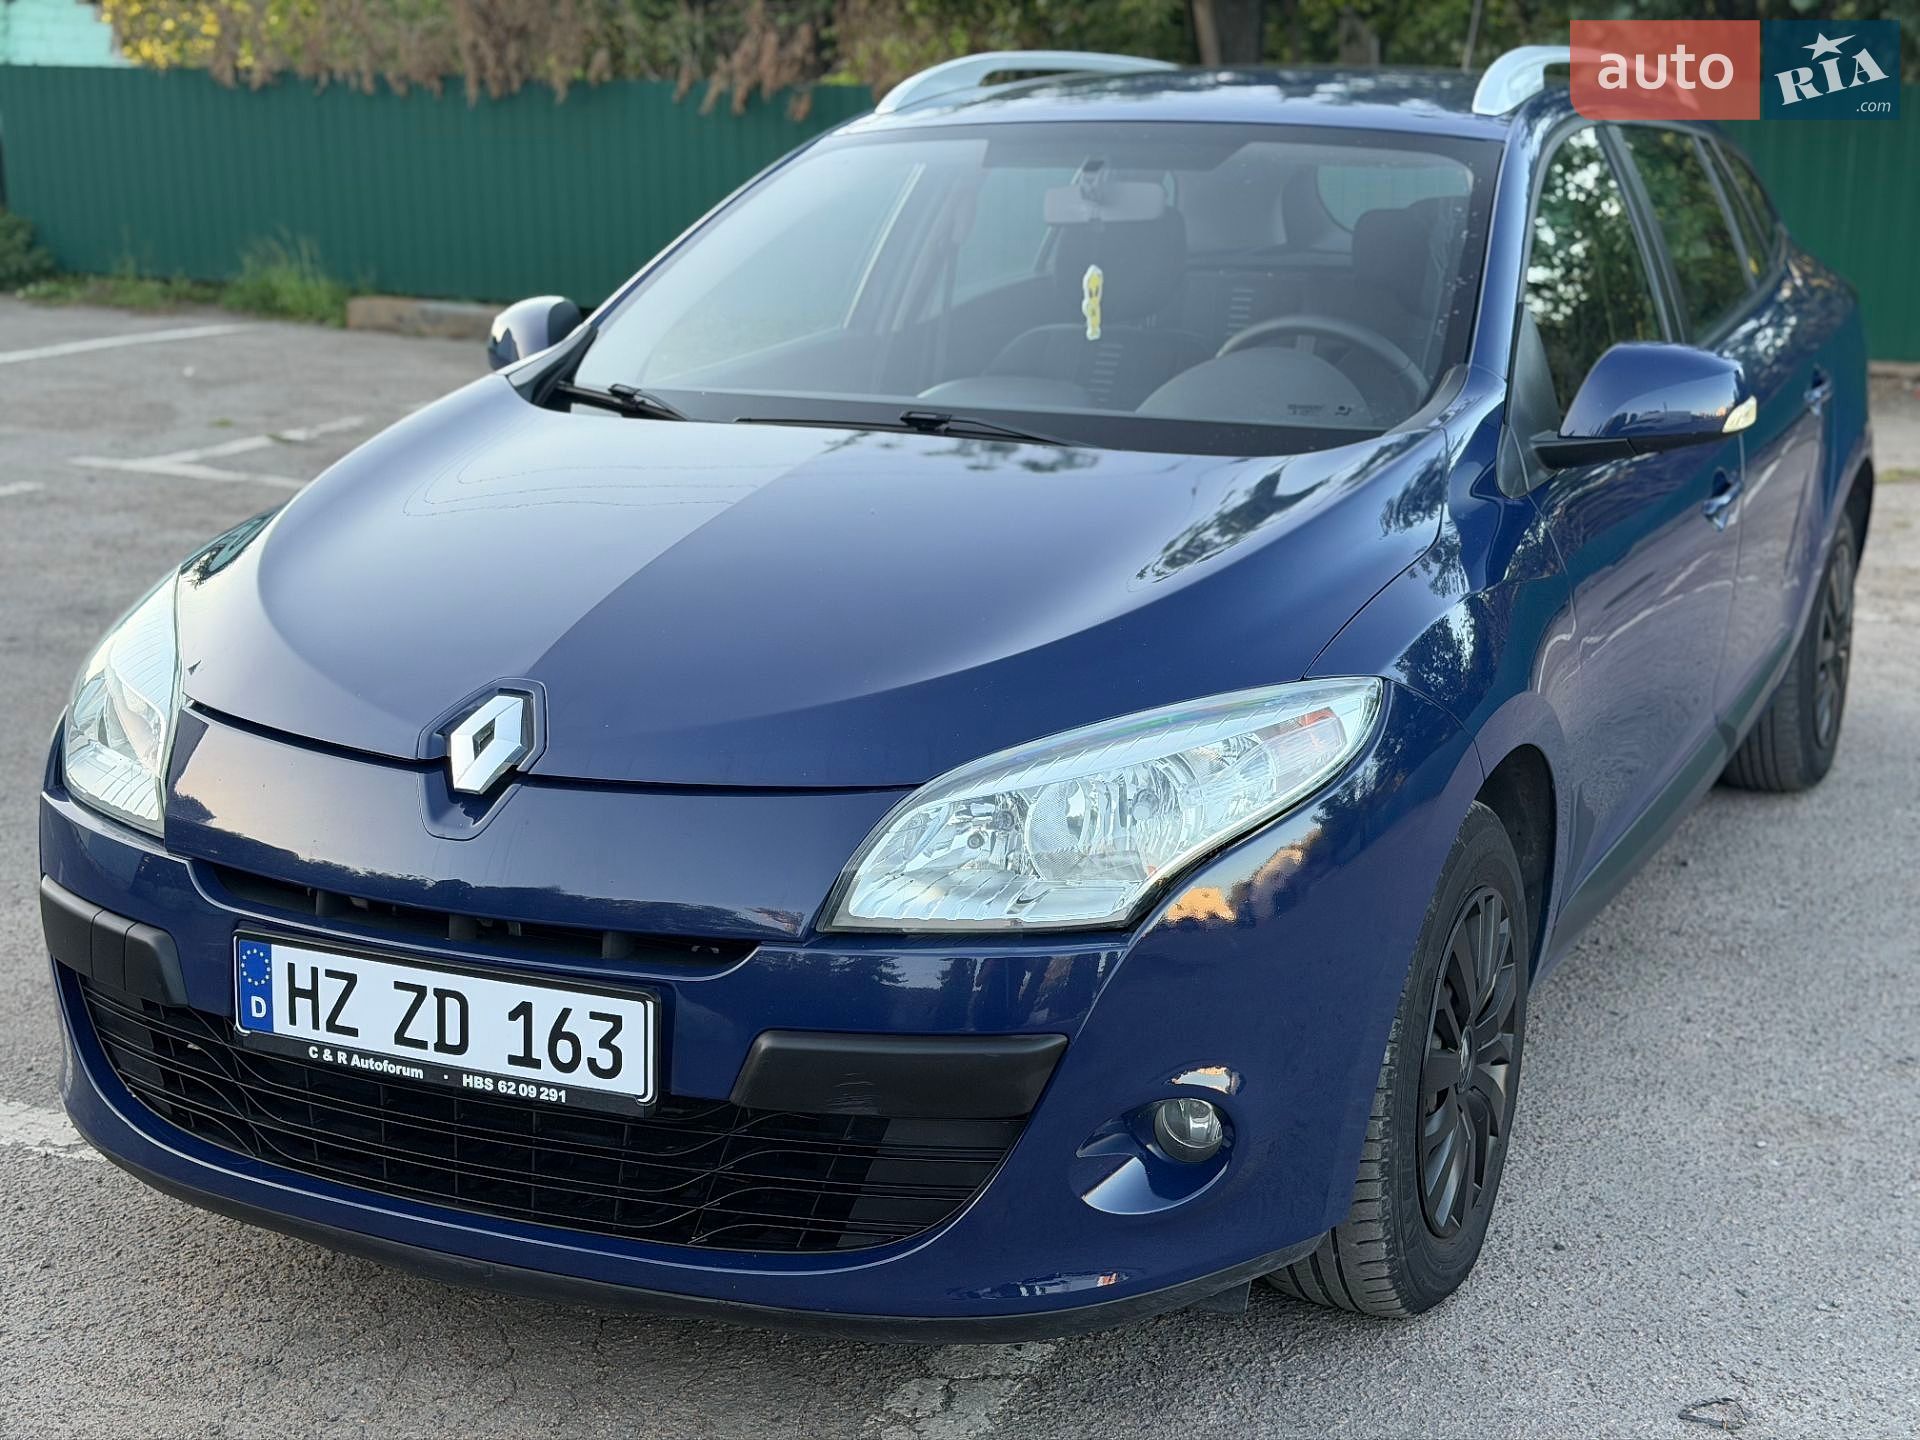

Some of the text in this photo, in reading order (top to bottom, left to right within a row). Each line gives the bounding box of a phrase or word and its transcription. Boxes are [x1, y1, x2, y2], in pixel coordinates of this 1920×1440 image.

[250, 996, 267, 1018] D
[287, 962, 623, 1080] HZ ZD 163
[308, 1046, 567, 1103] C & R Autoforum HBS 62 09 291
